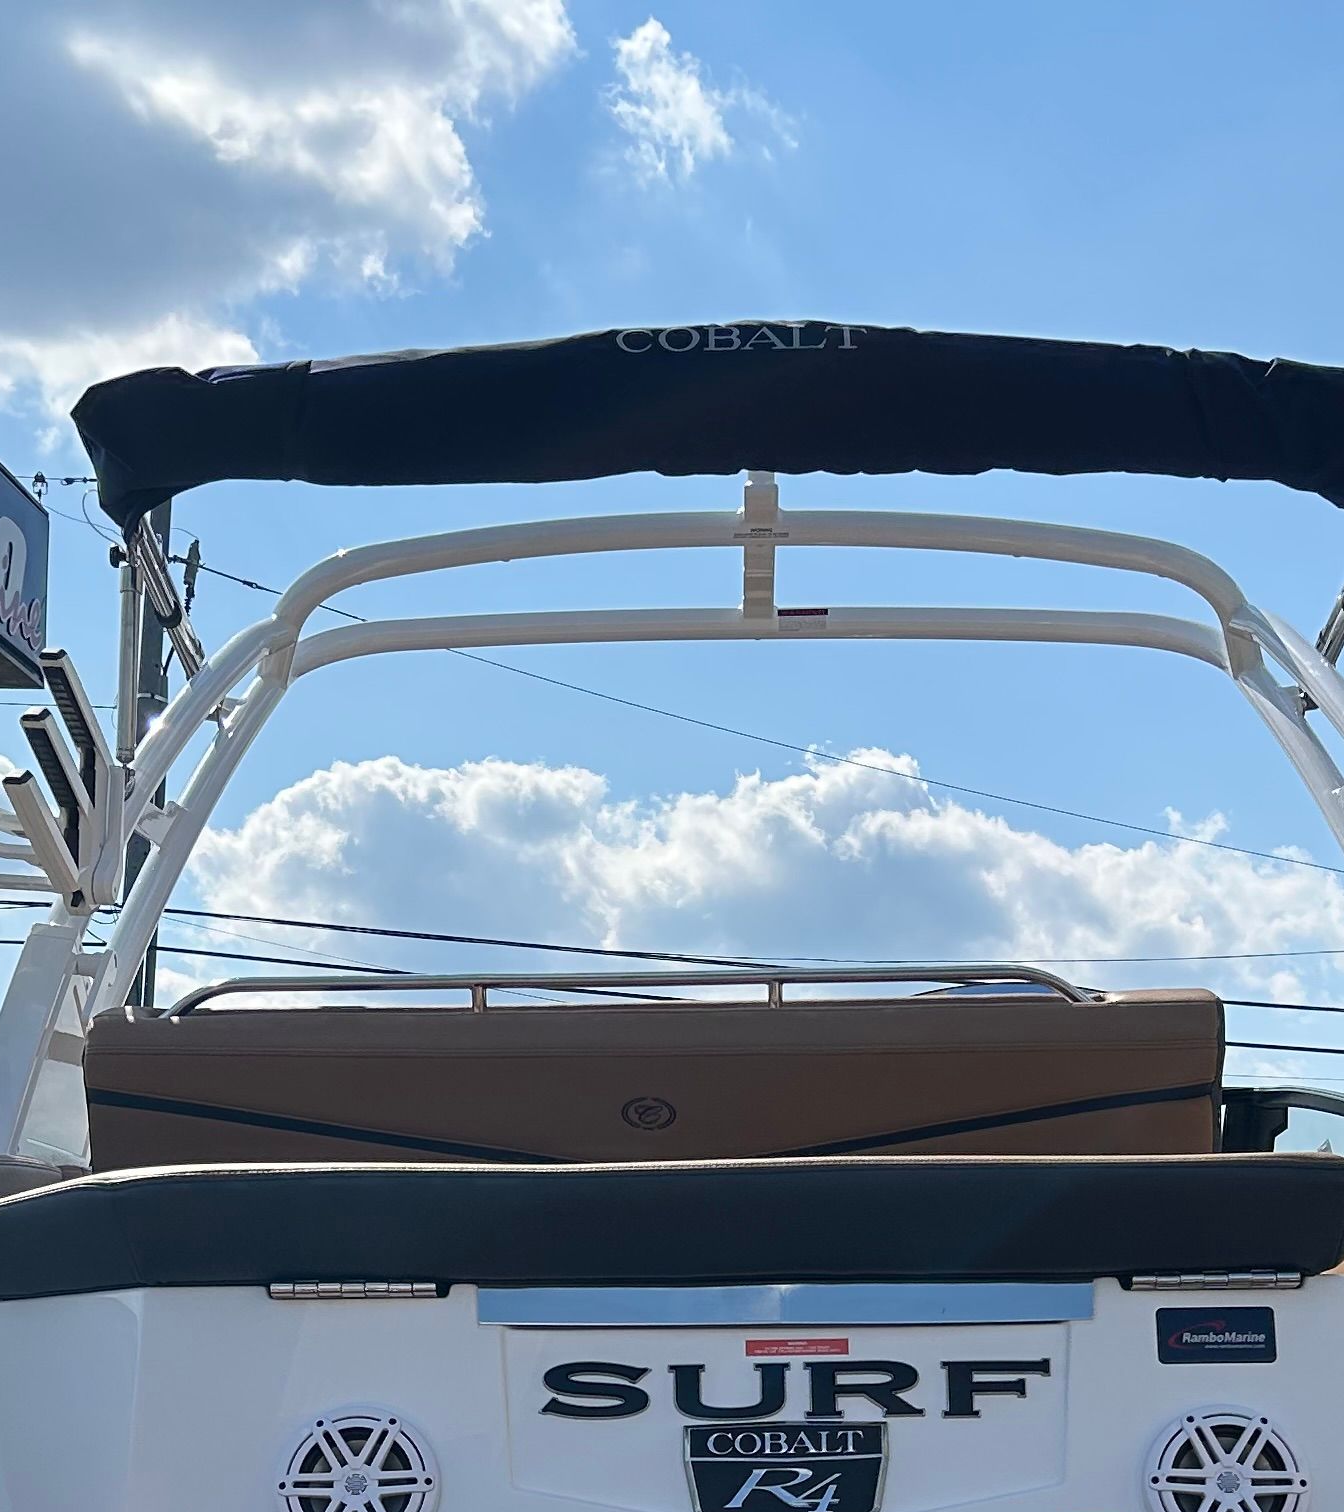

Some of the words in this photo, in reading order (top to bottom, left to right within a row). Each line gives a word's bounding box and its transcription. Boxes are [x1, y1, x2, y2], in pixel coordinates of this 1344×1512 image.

[614, 325, 868, 353] COBALT
[1182, 1330, 1266, 1343] RamboMarine
[537, 1357, 1051, 1421] SURF
[706, 1429, 864, 1456] COBALT
